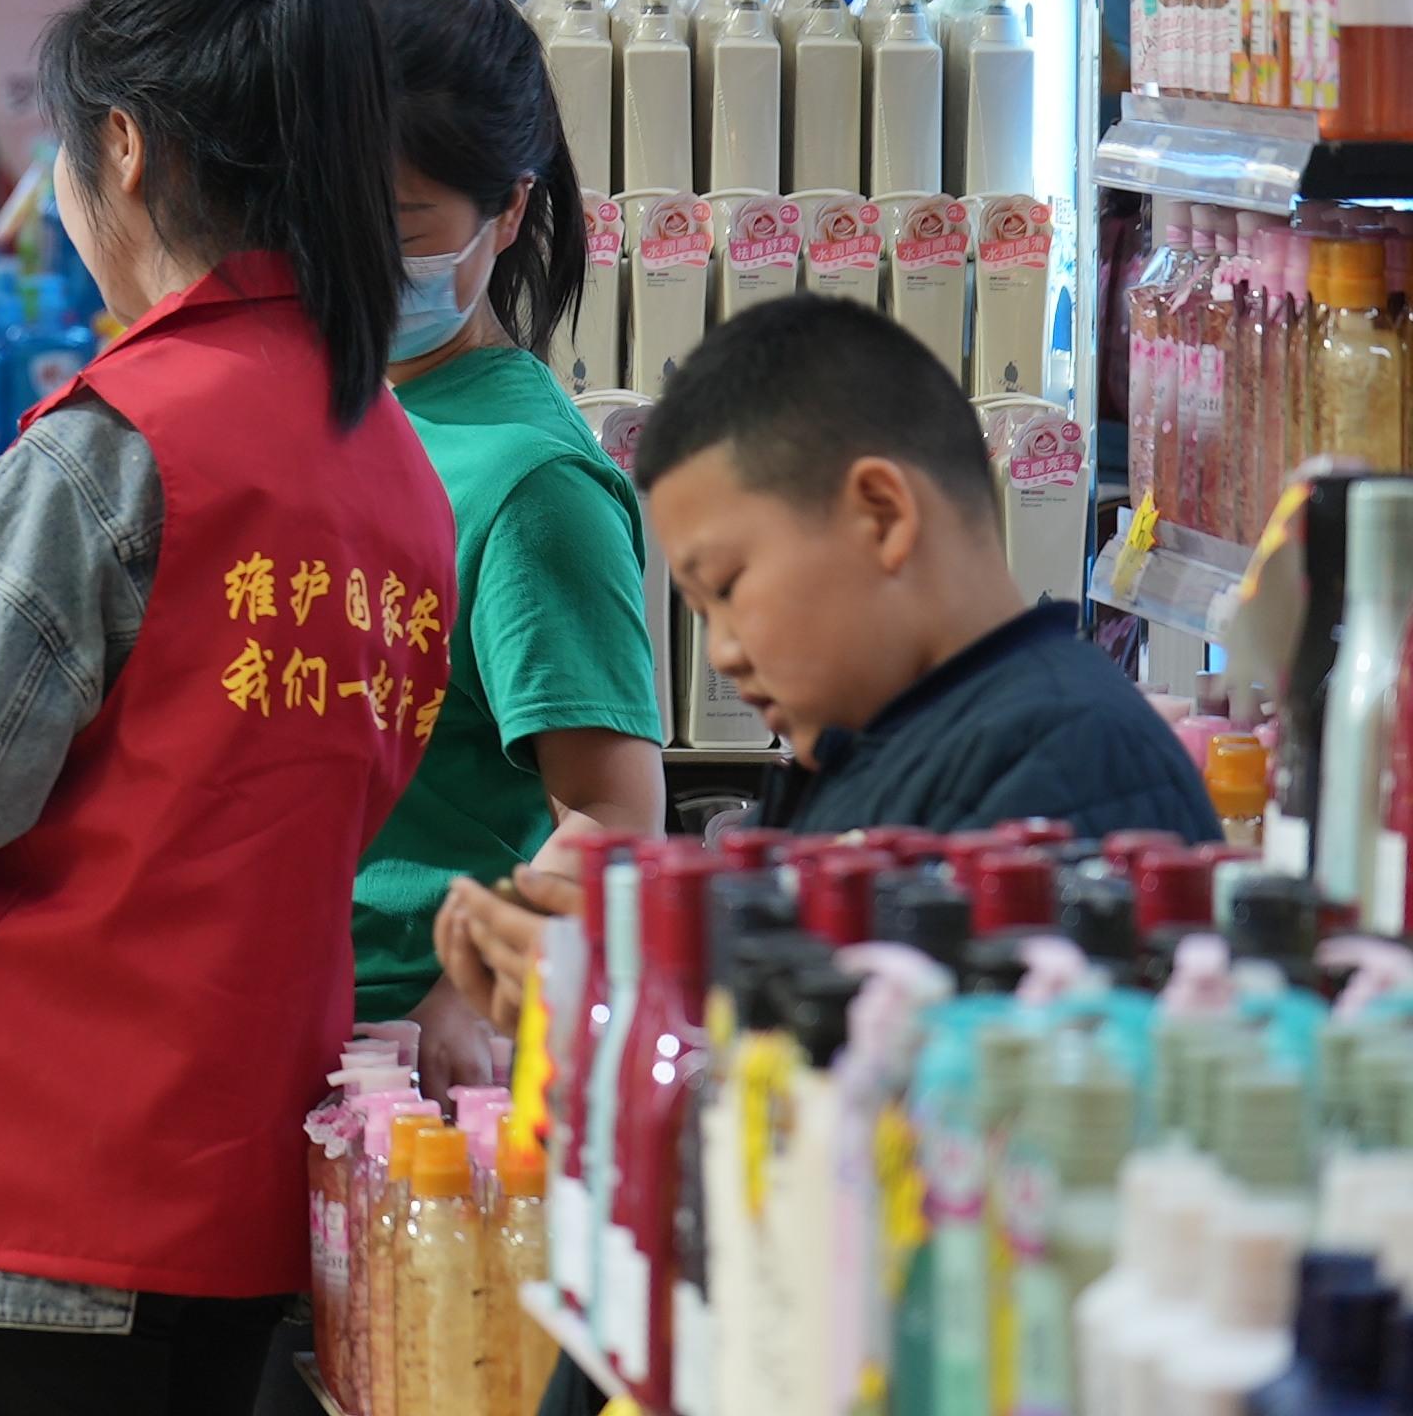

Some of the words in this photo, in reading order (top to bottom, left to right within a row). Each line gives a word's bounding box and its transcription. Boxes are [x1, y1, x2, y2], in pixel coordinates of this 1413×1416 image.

[223, 551, 452, 667] 维护国家安
